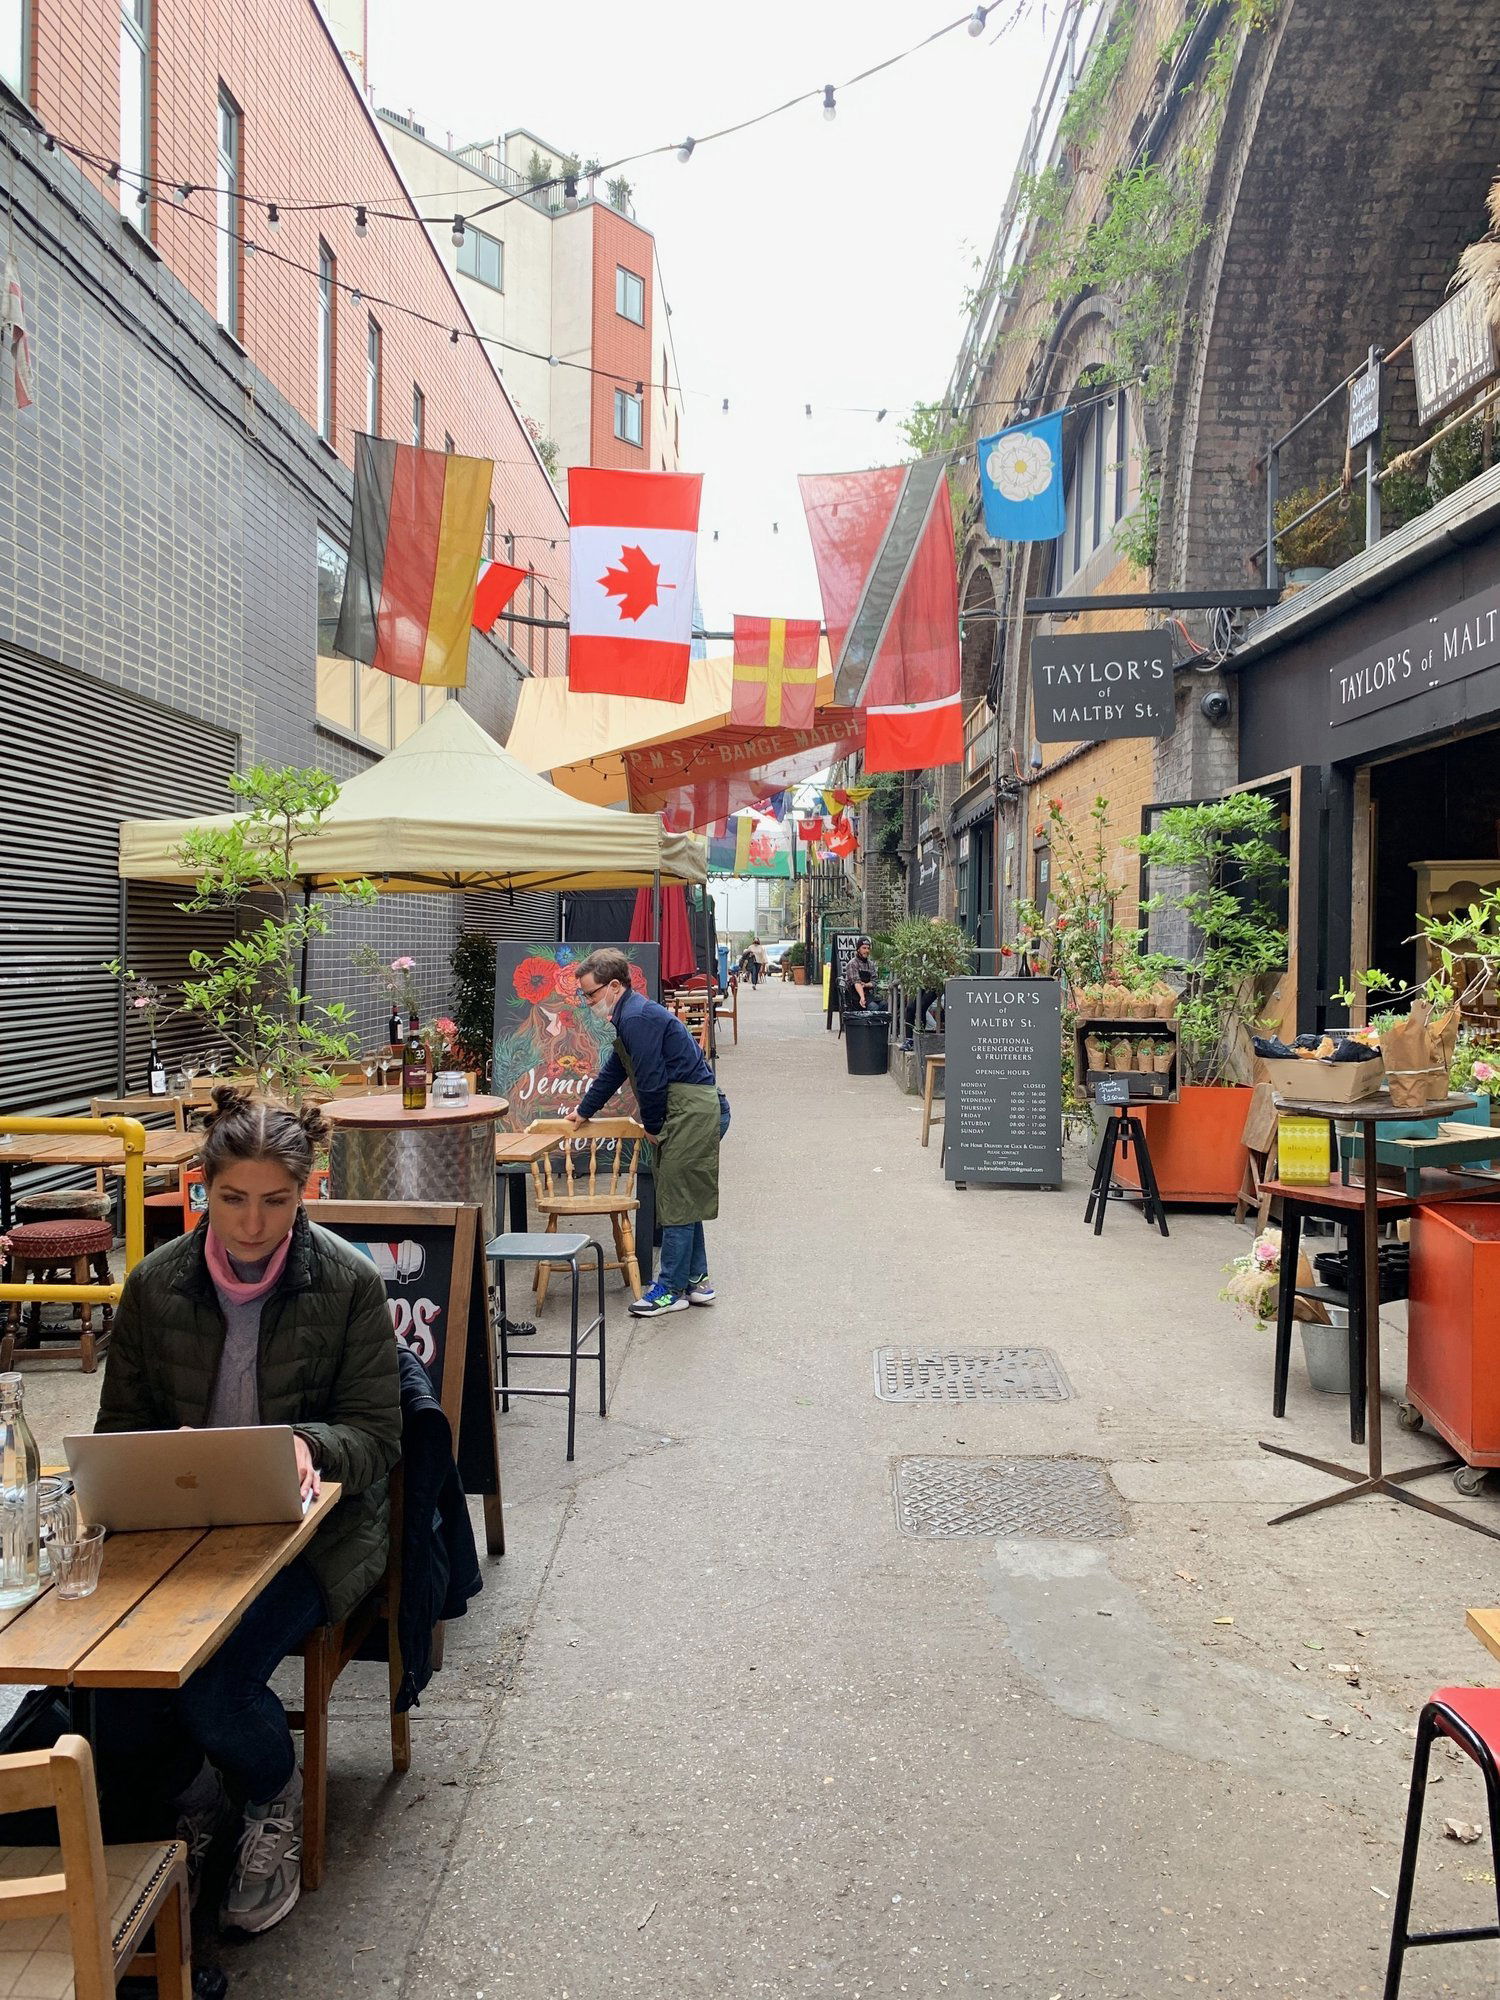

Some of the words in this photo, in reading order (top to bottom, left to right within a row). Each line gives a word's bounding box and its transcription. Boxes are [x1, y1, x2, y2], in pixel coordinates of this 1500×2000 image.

[1352, 374, 1376, 409] Studio
[1042, 659, 1164, 685] TAYLOR'S
[1339, 649, 1412, 705] TAYLOR'S
[1421, 649, 1433, 671] of
[1098, 686, 1111, 698] of
[1052, 704, 1125, 723] MALTBY
[1134, 703, 1159, 718] St.
[718, 736, 783, 763] BARGE
[792, 718, 860, 748] MATCH
[966, 992, 1040, 1004] TAYLOR'S
[970, 1018, 1015, 1027] MALTBY
[1020, 1018, 1036, 1028] St.
[558, 1102, 569, 1115] in
